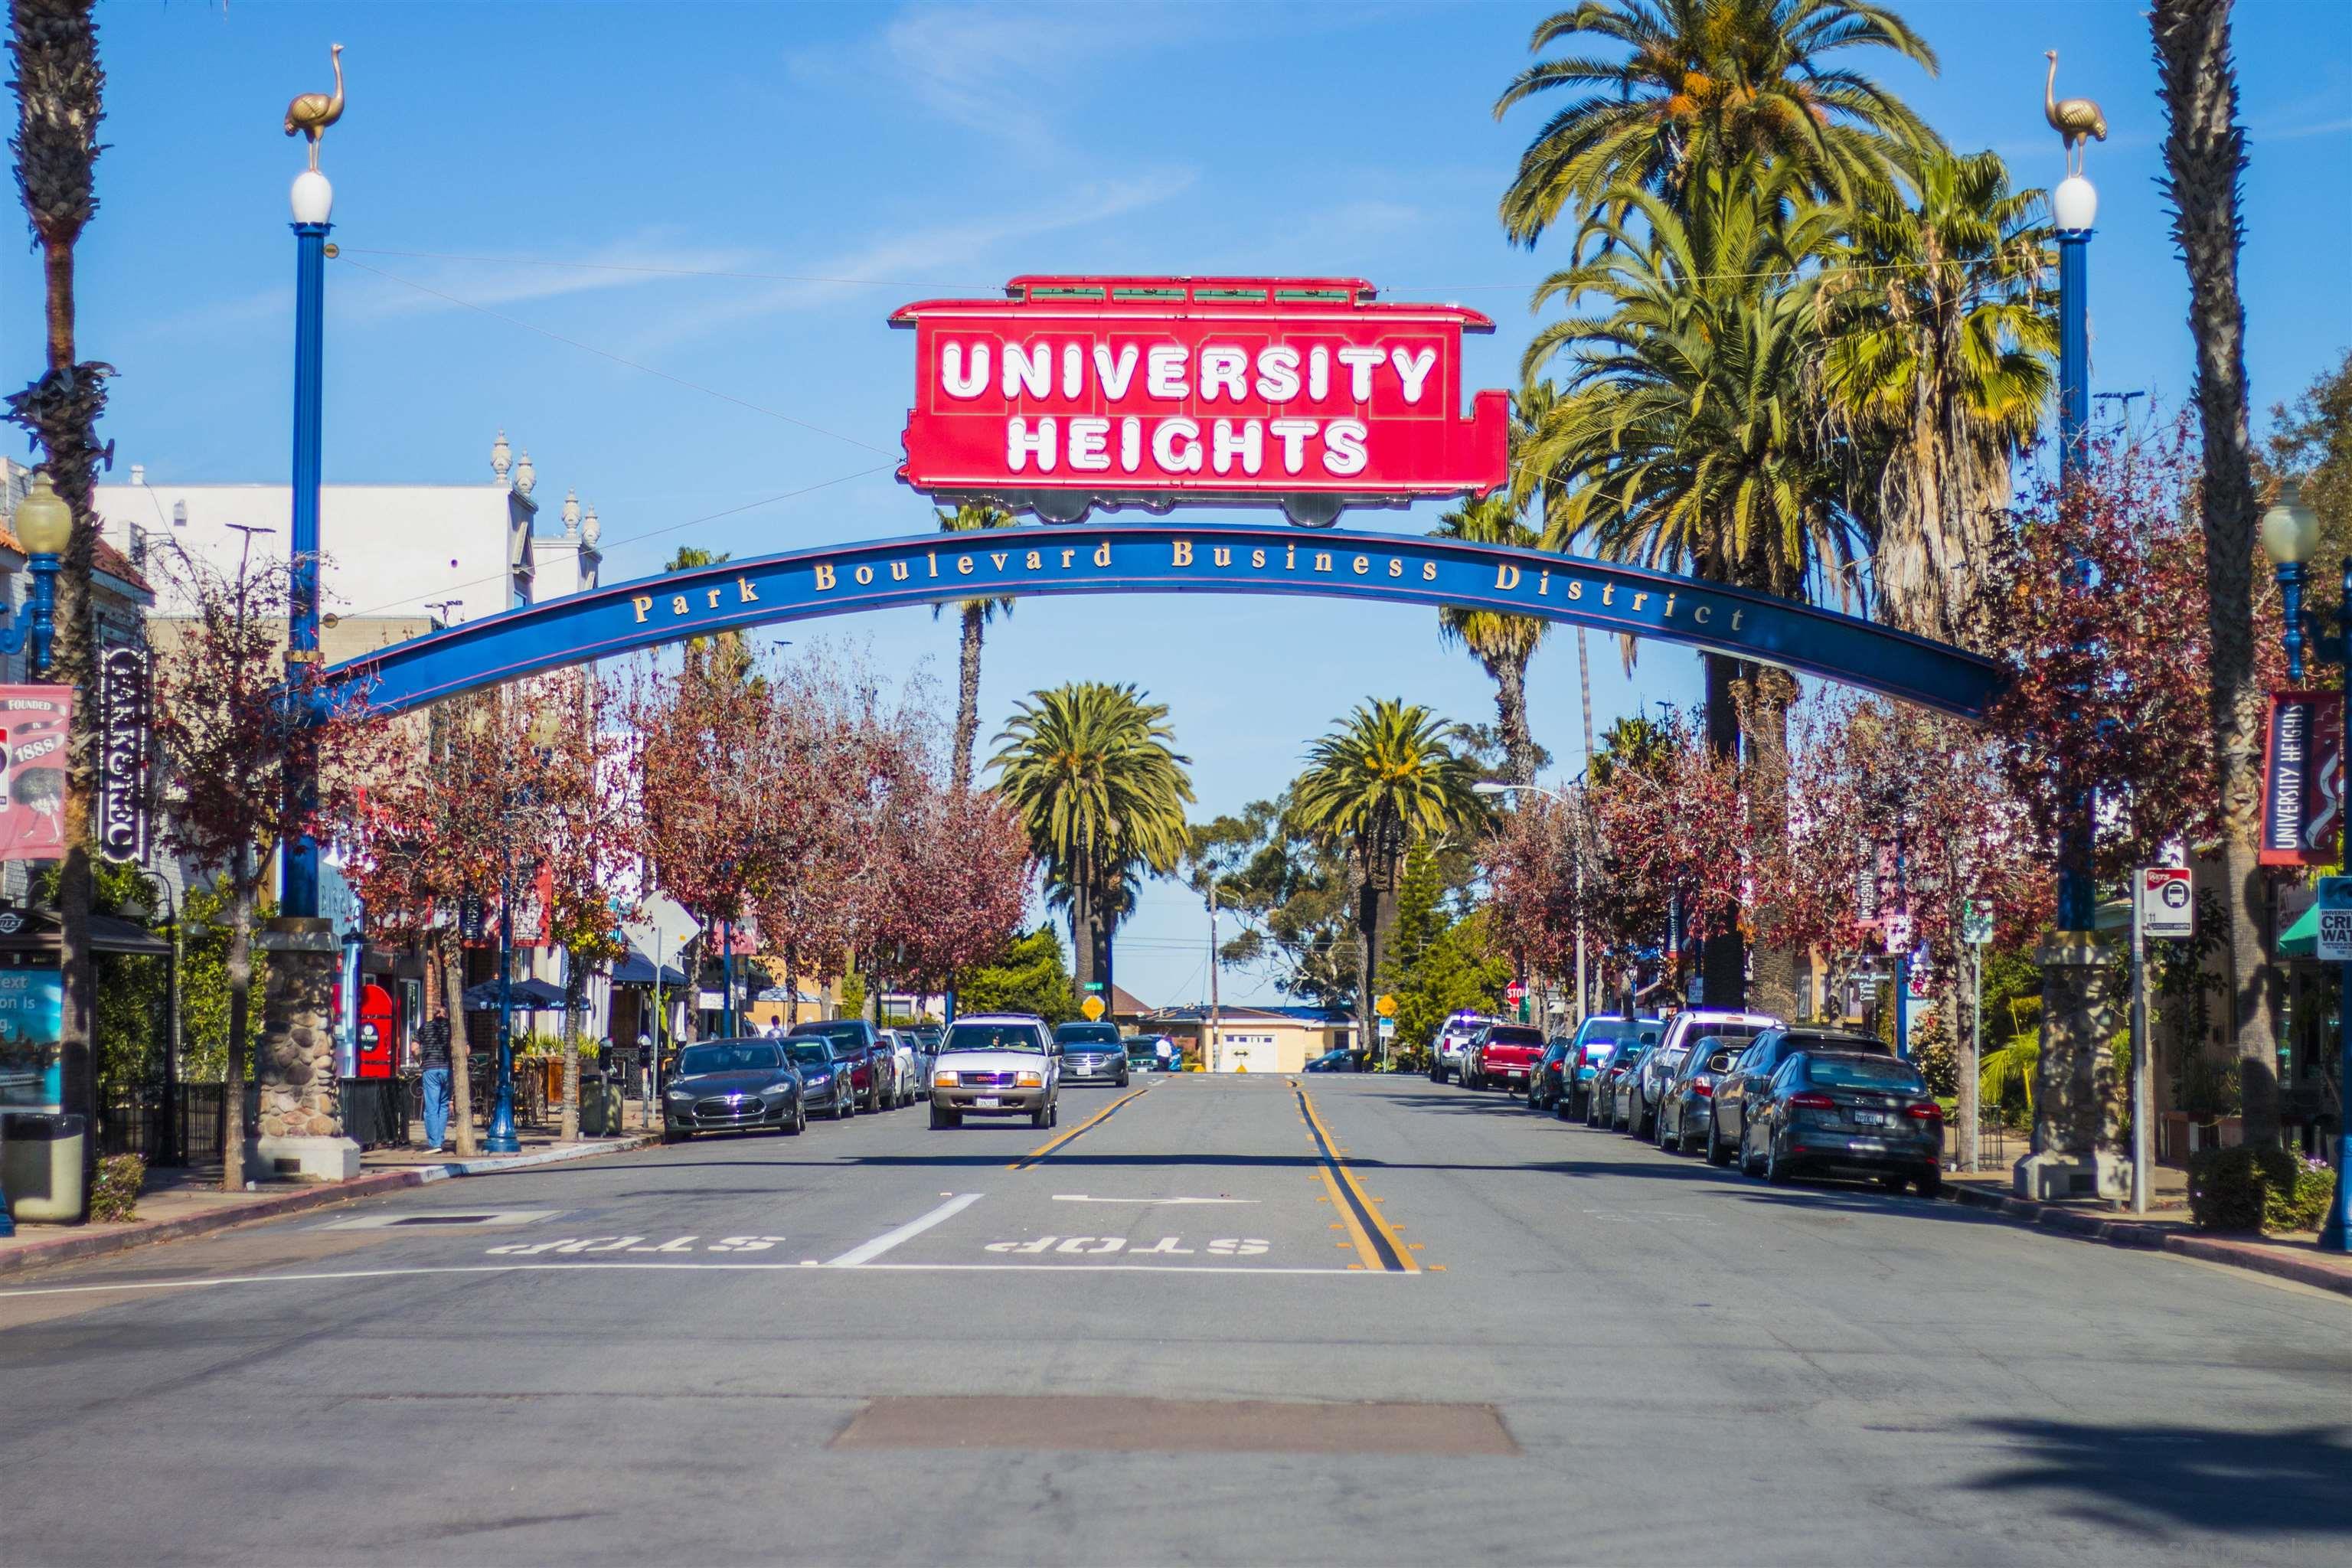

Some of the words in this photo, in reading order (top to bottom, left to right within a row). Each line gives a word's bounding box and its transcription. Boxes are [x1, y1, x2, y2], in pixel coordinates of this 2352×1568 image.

[942, 342, 1438, 405] UNIVERSITY
[1005, 416, 1369, 476] HEIGHTS
[632, 577, 760, 623] Park
[815, 541, 1112, 592] Boulevard
[1171, 541, 1437, 582] Business
[1494, 564, 1743, 632] District
[8, 700, 51, 711] FOUNDED
[2280, 704, 2303, 762] HEIGHTS
[15, 737, 55, 763] 1888
[2275, 767, 2300, 849] UNIVERSITY
[2148, 913, 2156, 922] 11
[2321, 916, 2351, 929] CRI
[24, 996, 35, 1009] is
[485, 1236, 786, 1255] STOP
[984, 1236, 1271, 1255] STOP
